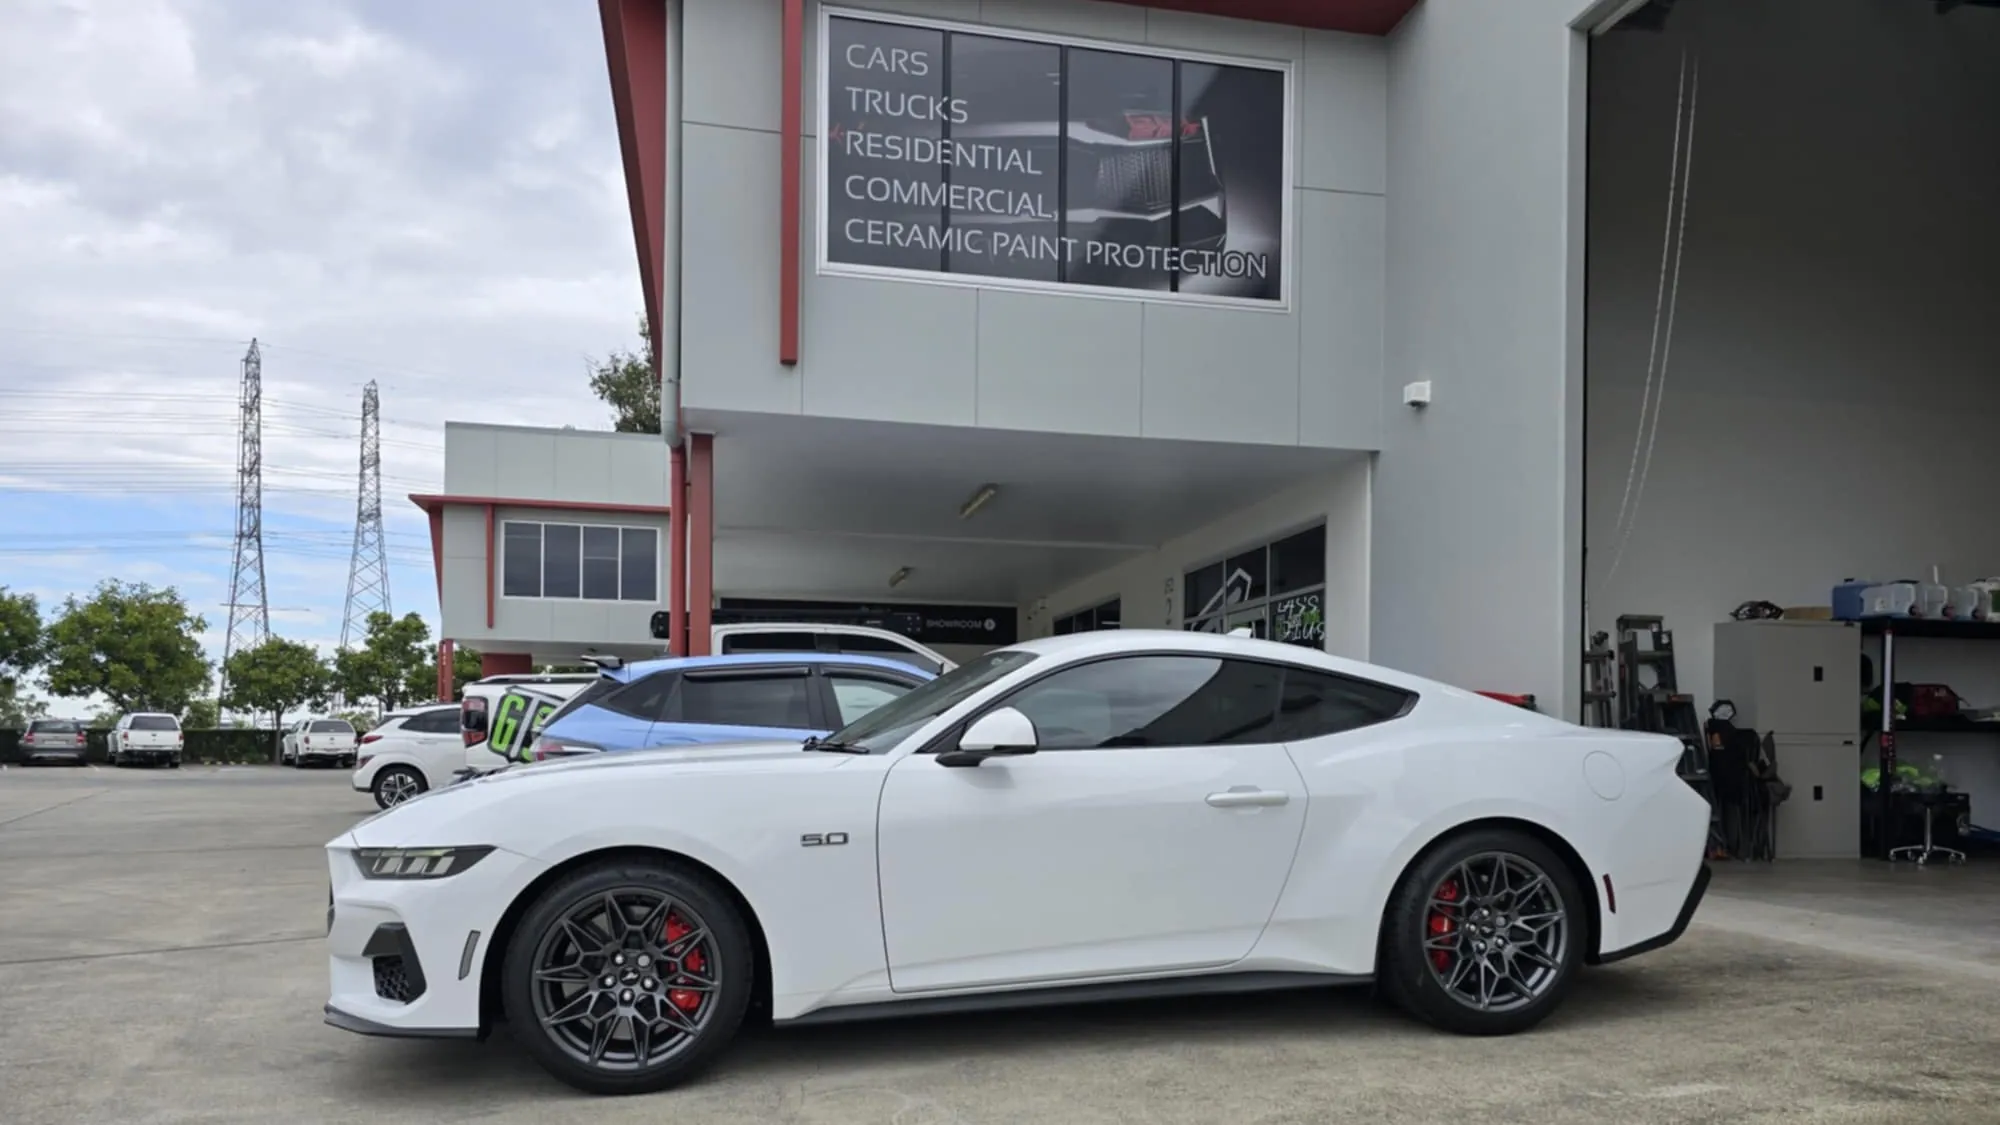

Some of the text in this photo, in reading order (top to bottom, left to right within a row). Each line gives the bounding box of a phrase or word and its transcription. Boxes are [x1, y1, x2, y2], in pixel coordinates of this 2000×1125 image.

[846, 44, 928, 76] CARS
[845, 86, 969, 123] TRUCKS
[846, 131, 1042, 175] RESIDENTIAL
[845, 218, 1267, 279] CERAMIC PAINT PROTECTION
[926, 618, 982, 630] SHOWROOM
